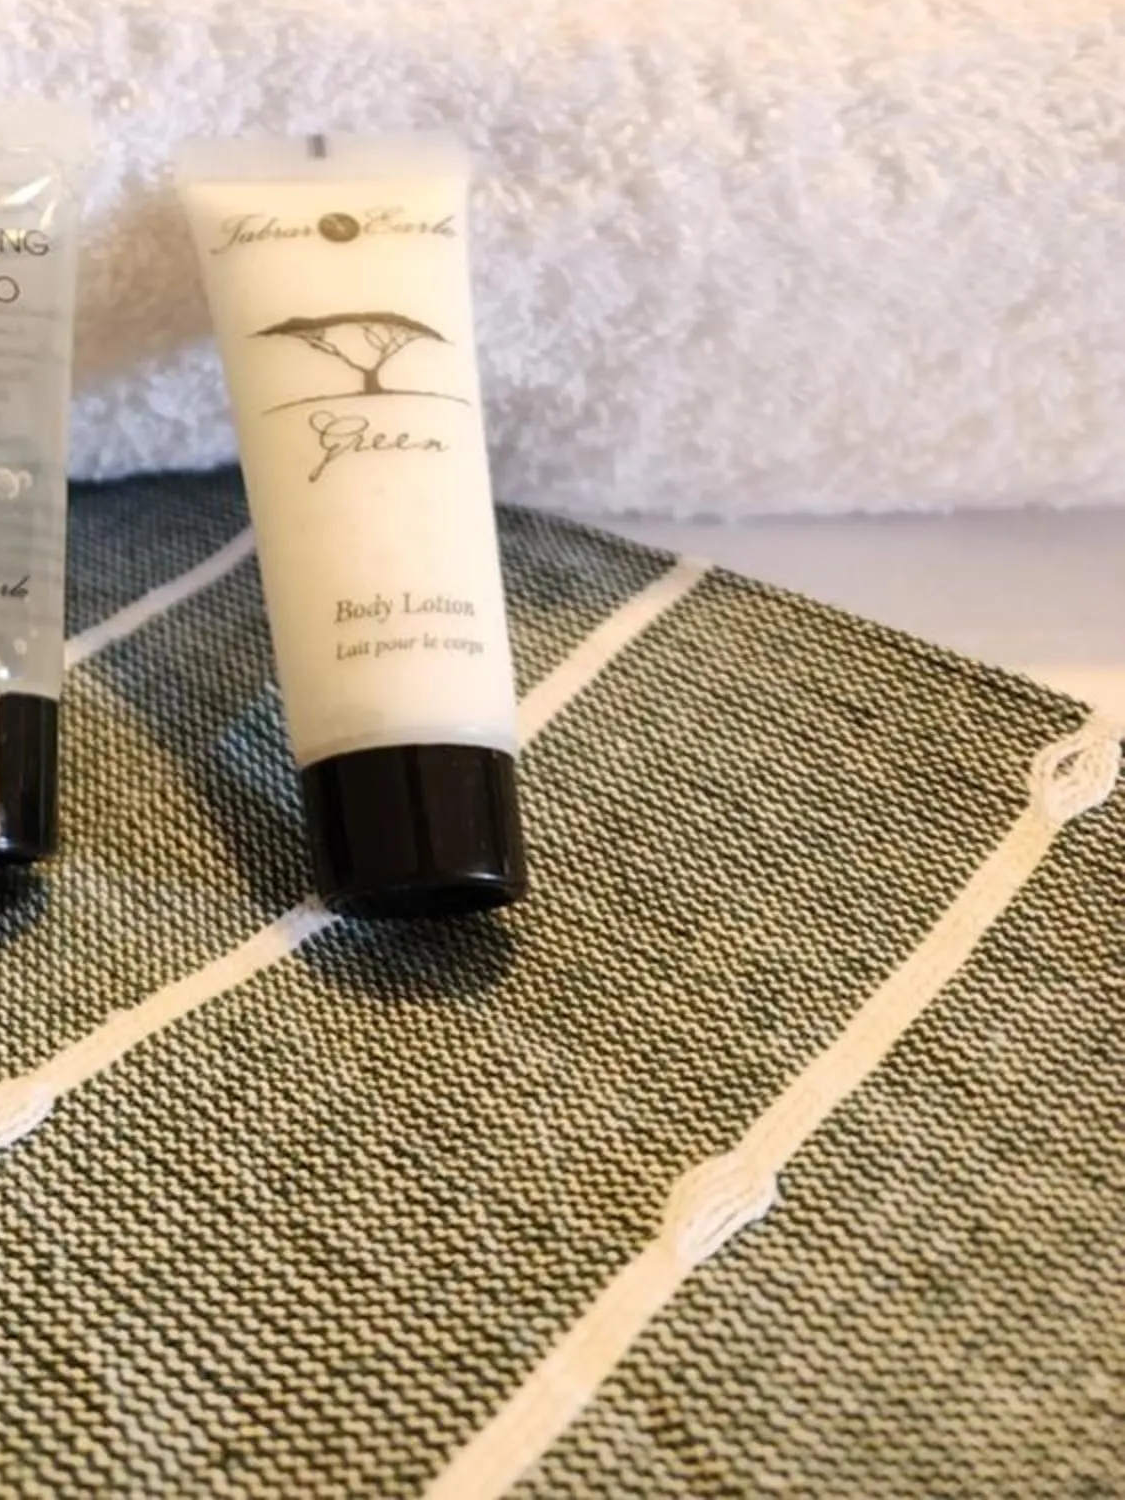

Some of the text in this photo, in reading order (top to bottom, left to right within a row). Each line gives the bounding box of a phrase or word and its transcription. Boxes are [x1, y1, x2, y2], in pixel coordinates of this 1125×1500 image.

[308, 410, 450, 483] Green
[334, 592, 476, 624] Body Lotion
[336, 641, 371, 661] Lait
[375, 636, 417, 658] pour
[423, 632, 438, 649] le
